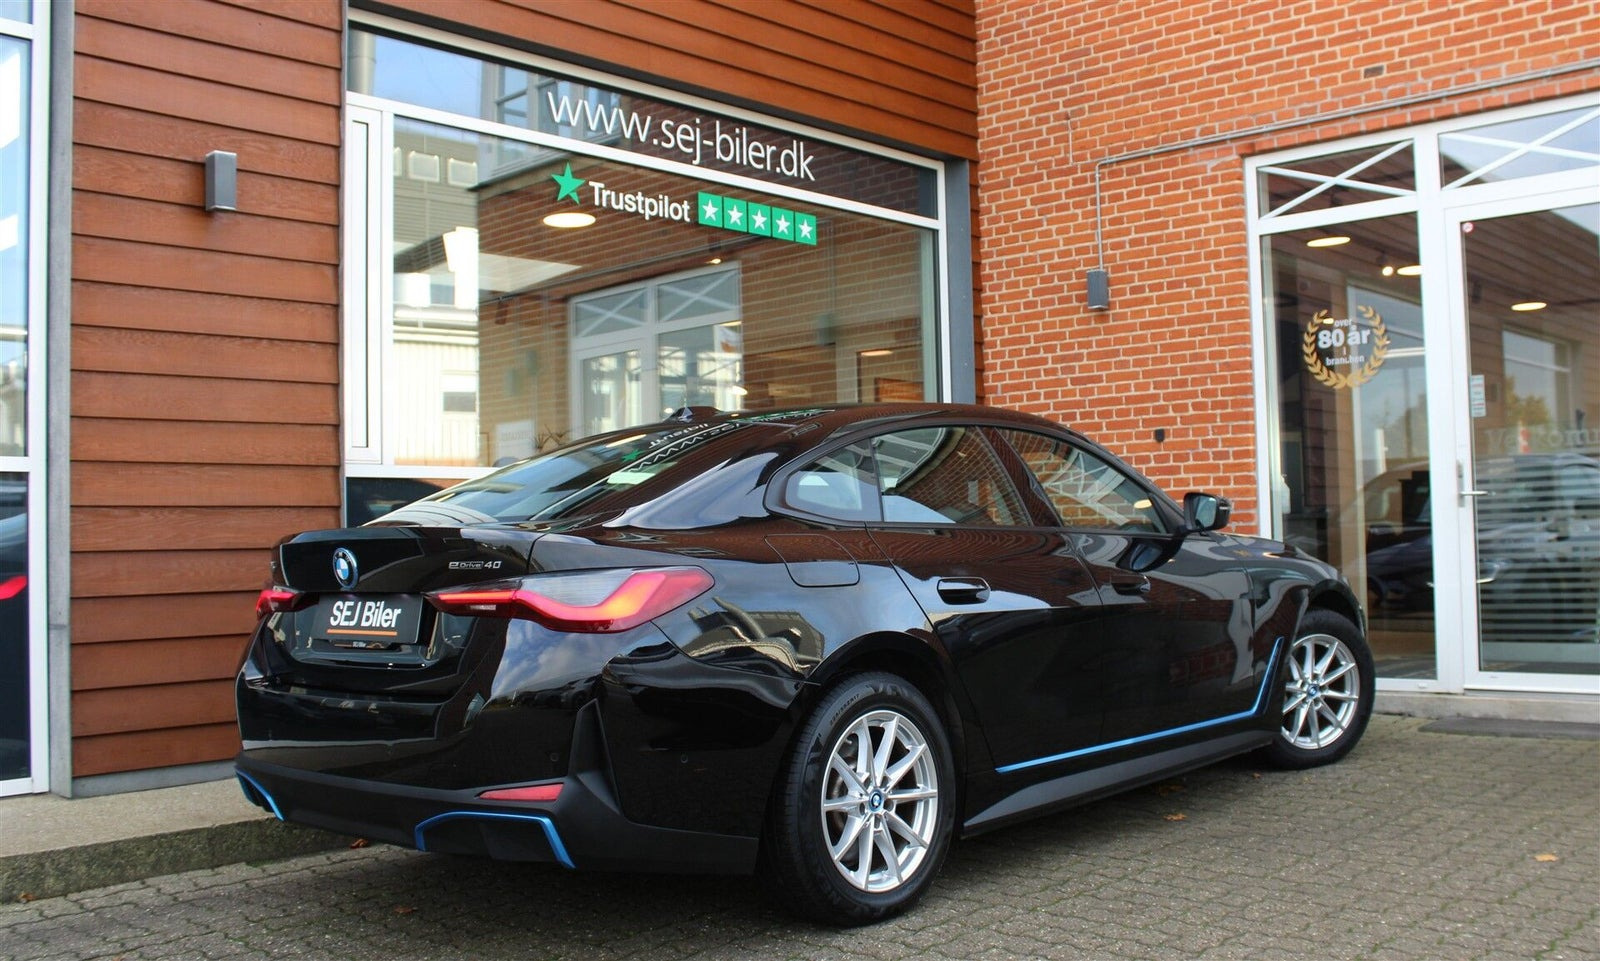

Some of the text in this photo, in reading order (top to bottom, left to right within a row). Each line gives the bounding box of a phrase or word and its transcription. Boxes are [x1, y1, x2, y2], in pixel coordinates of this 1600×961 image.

[547, 91, 816, 182] www.sej-biler.dk
[588, 180, 691, 223] Trustpilot
[1317, 325, 1371, 348] 80 år
[484, 560, 503, 569] 40
[330, 600, 402, 628] SEJ Biler
